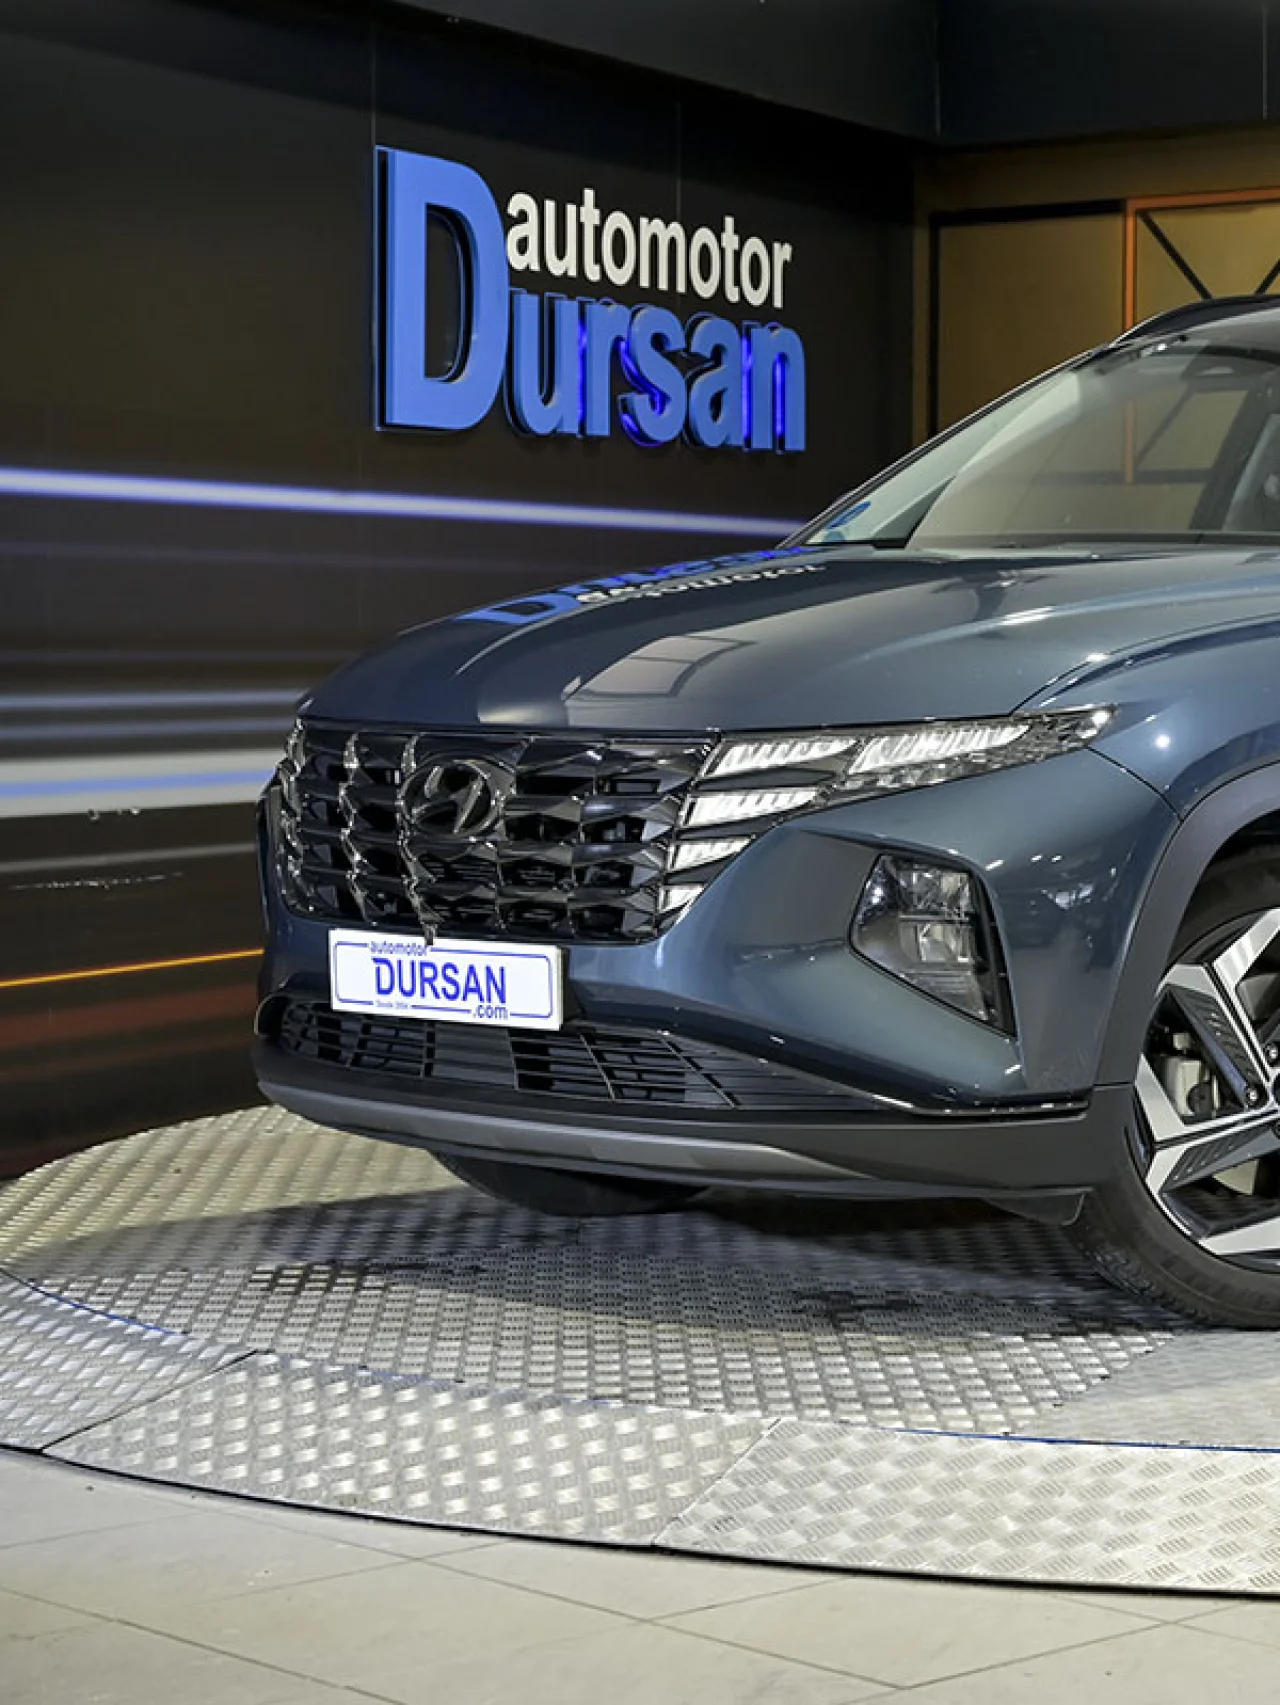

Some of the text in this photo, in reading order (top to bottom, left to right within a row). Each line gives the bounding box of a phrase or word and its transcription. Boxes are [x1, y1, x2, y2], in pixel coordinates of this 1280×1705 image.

[506, 187, 792, 308] automotor
[375, 145, 806, 452] Dursan
[370, 941, 427, 956] automotor
[372, 957, 507, 1004] DURSAN
[473, 1004, 509, 1019] .com
